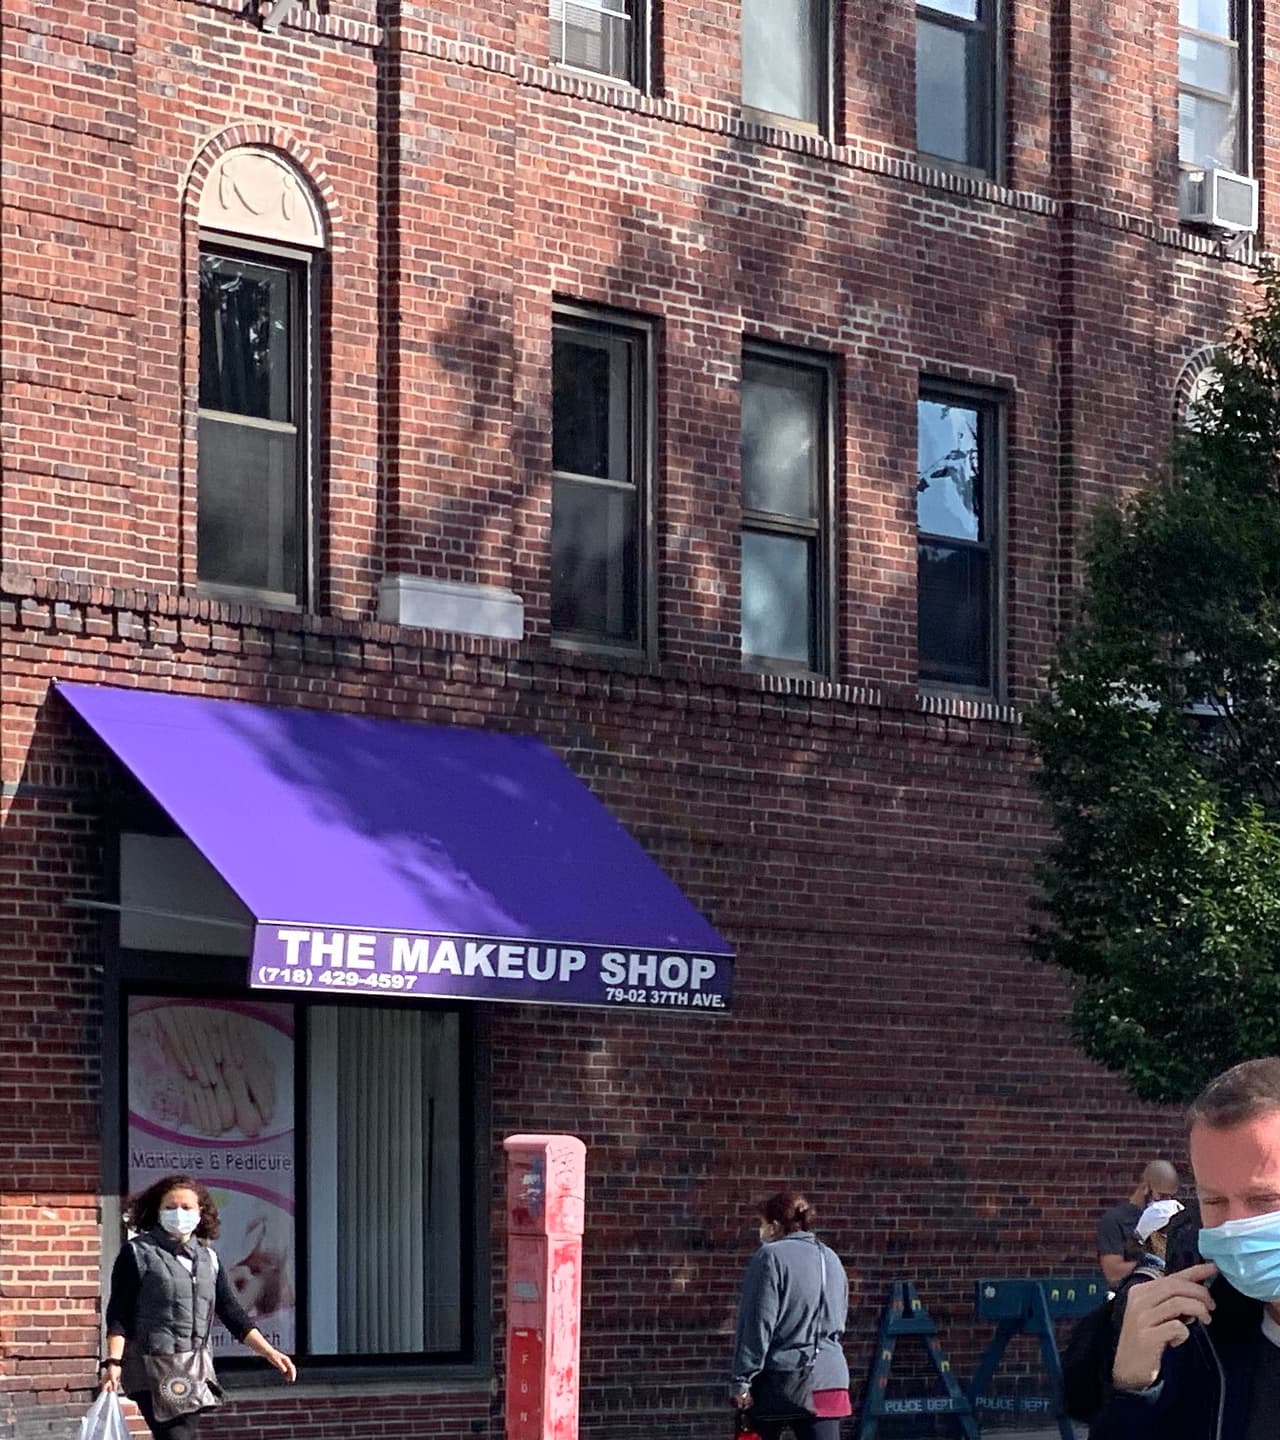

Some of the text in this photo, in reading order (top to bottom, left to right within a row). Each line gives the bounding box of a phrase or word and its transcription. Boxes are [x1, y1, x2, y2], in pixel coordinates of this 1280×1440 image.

[278, 929, 716, 990] THE MAKEUP SHOP
[258, 966, 418, 990] (718) 429-4597
[606, 988, 726, 1008] 79-02 37TH AVE.
[131, 1151, 292, 1170] Manicure & Pedicure
[885, 1398, 953, 1412] POLICE DEPT
[975, 1396, 1015, 1410] POLICE
